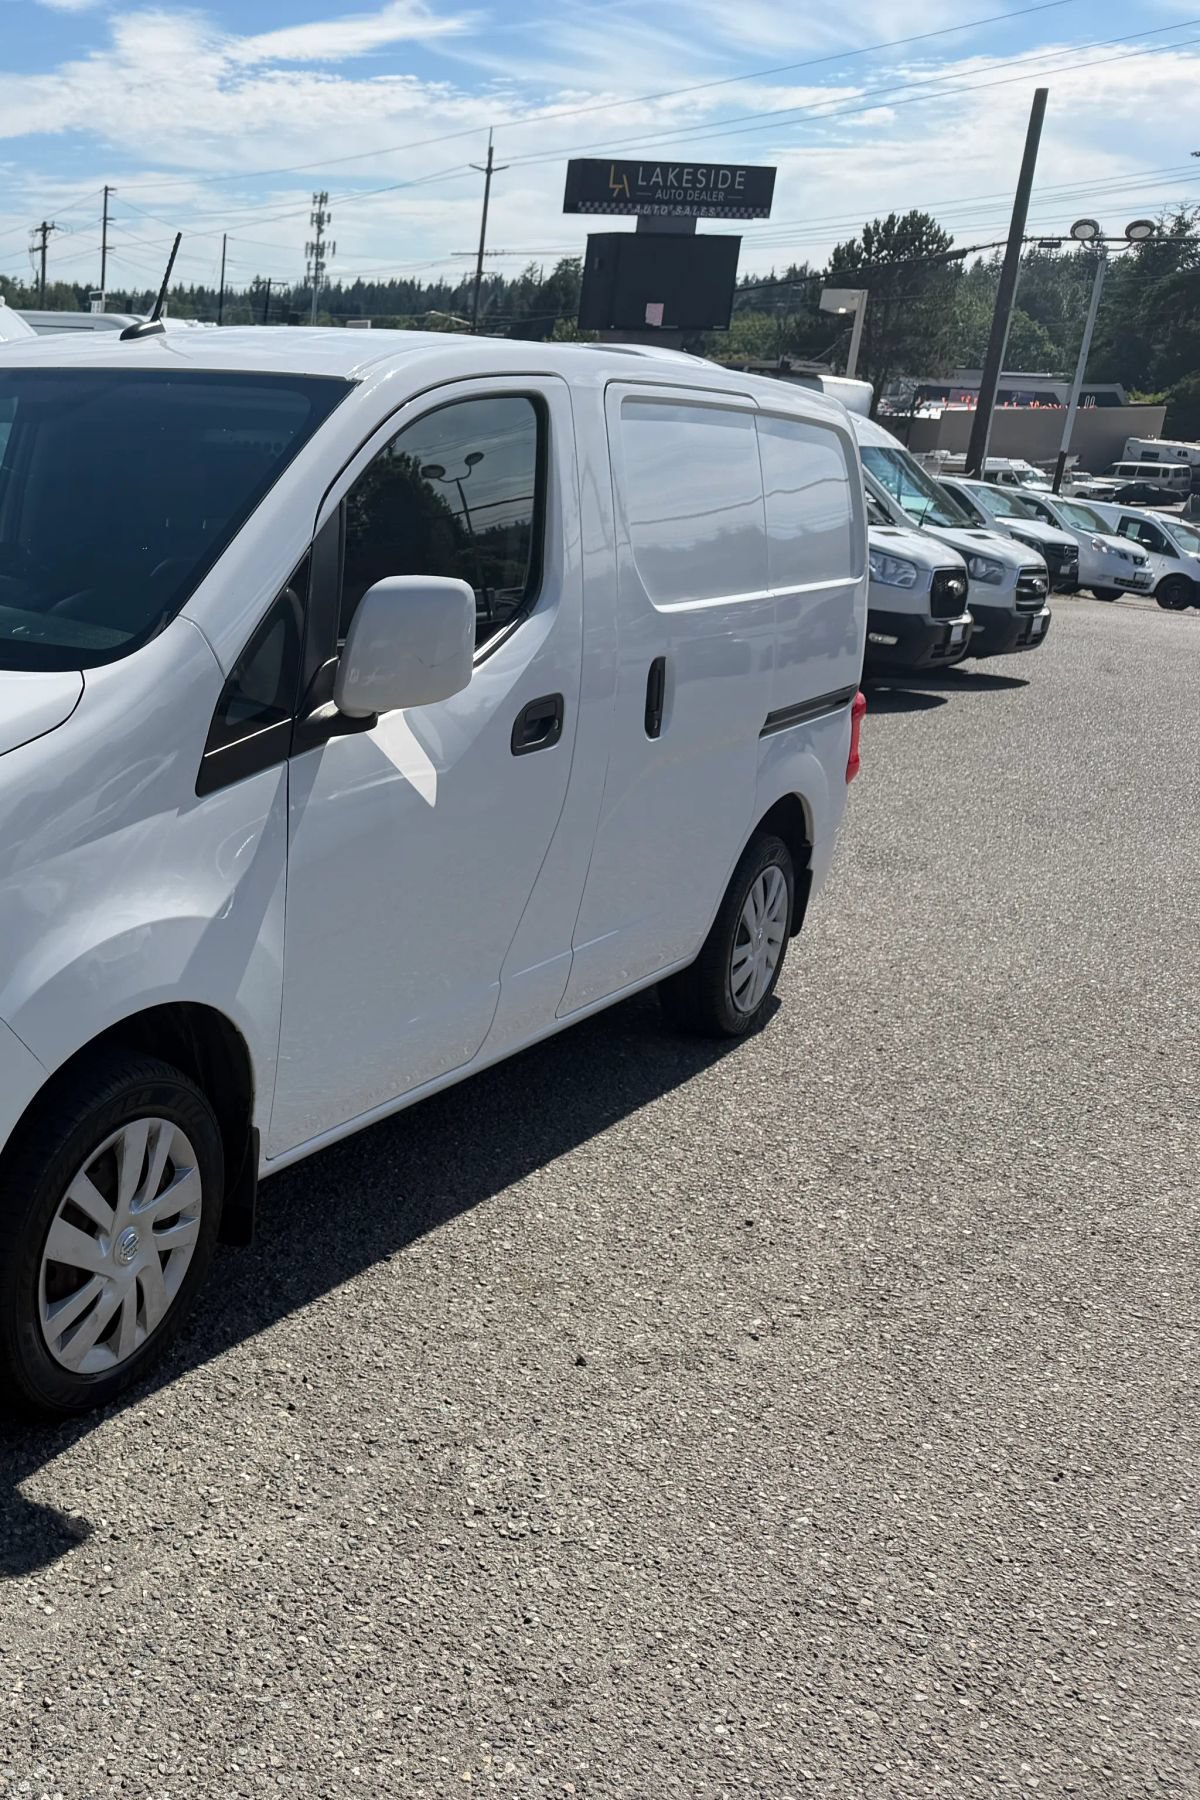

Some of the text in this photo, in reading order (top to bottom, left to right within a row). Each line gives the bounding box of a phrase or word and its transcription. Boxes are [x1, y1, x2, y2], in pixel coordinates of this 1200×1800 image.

[638, 166, 747, 190] LAKESIDE
[655, 190, 725, 202] AUTO DEALER
[633, 204, 717, 218] AUTO SALES
